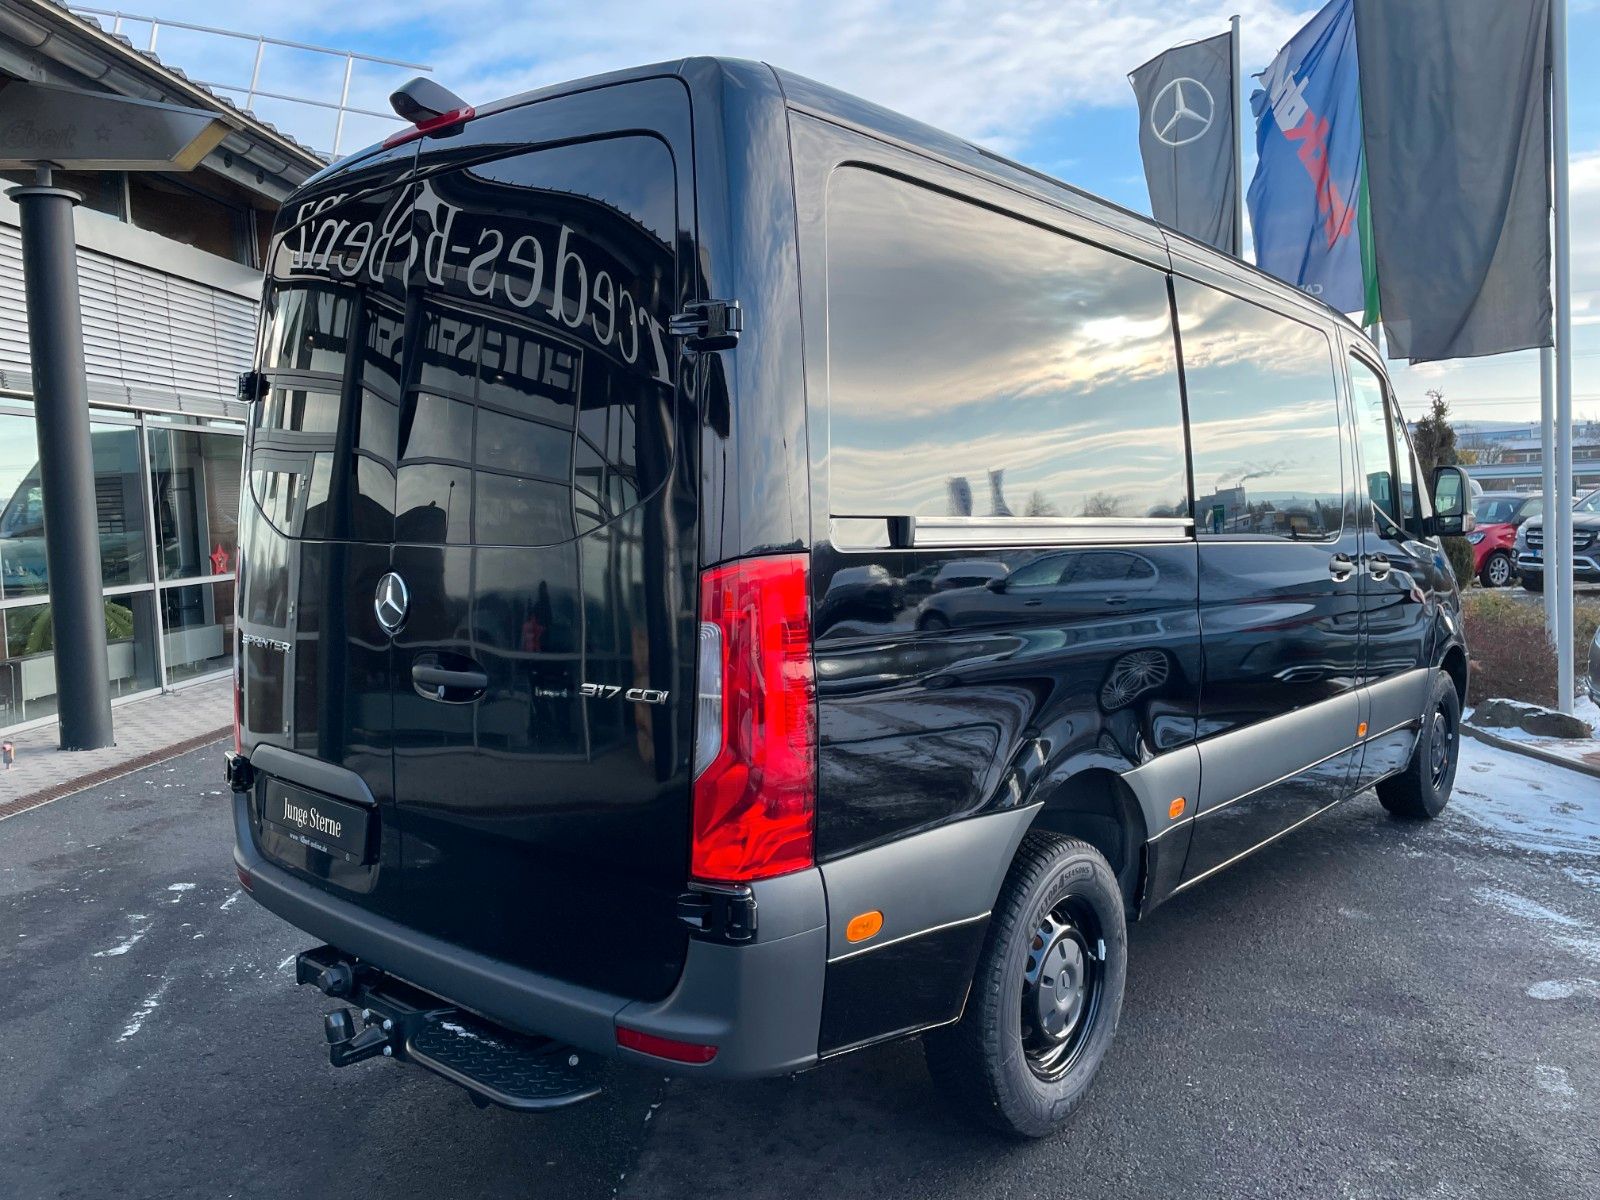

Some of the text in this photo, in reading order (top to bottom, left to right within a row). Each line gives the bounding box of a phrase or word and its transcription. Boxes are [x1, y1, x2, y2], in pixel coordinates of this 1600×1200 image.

[579, 683, 622, 698] 317
[625, 688, 669, 705] CDI
[283, 797, 341, 838] Junge Sterne
